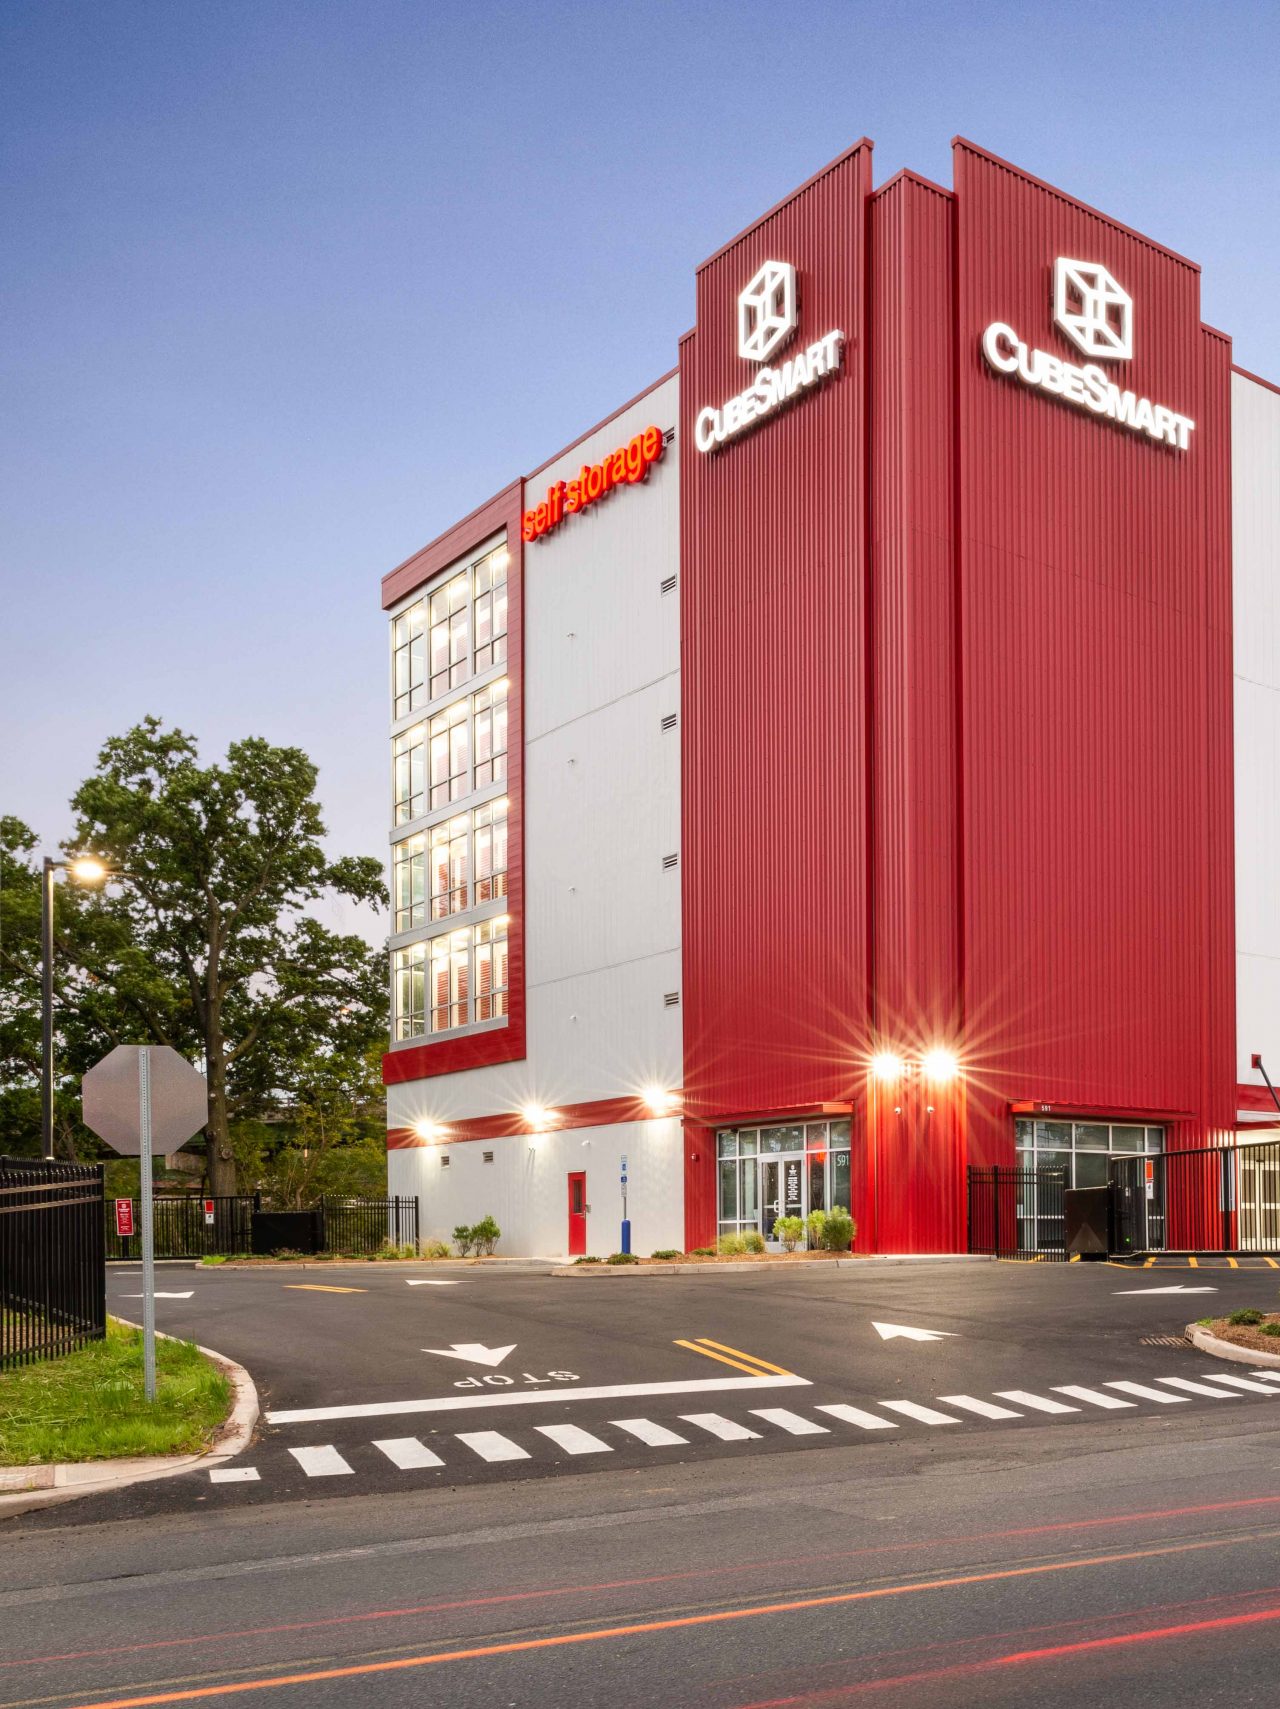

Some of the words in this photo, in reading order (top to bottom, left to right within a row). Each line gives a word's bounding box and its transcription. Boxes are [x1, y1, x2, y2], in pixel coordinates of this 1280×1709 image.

[523, 481, 566, 542] self
[566, 425, 663, 515] storage
[837, 1154, 849, 1167] 591
[453, 1370, 580, 1388] STOP
